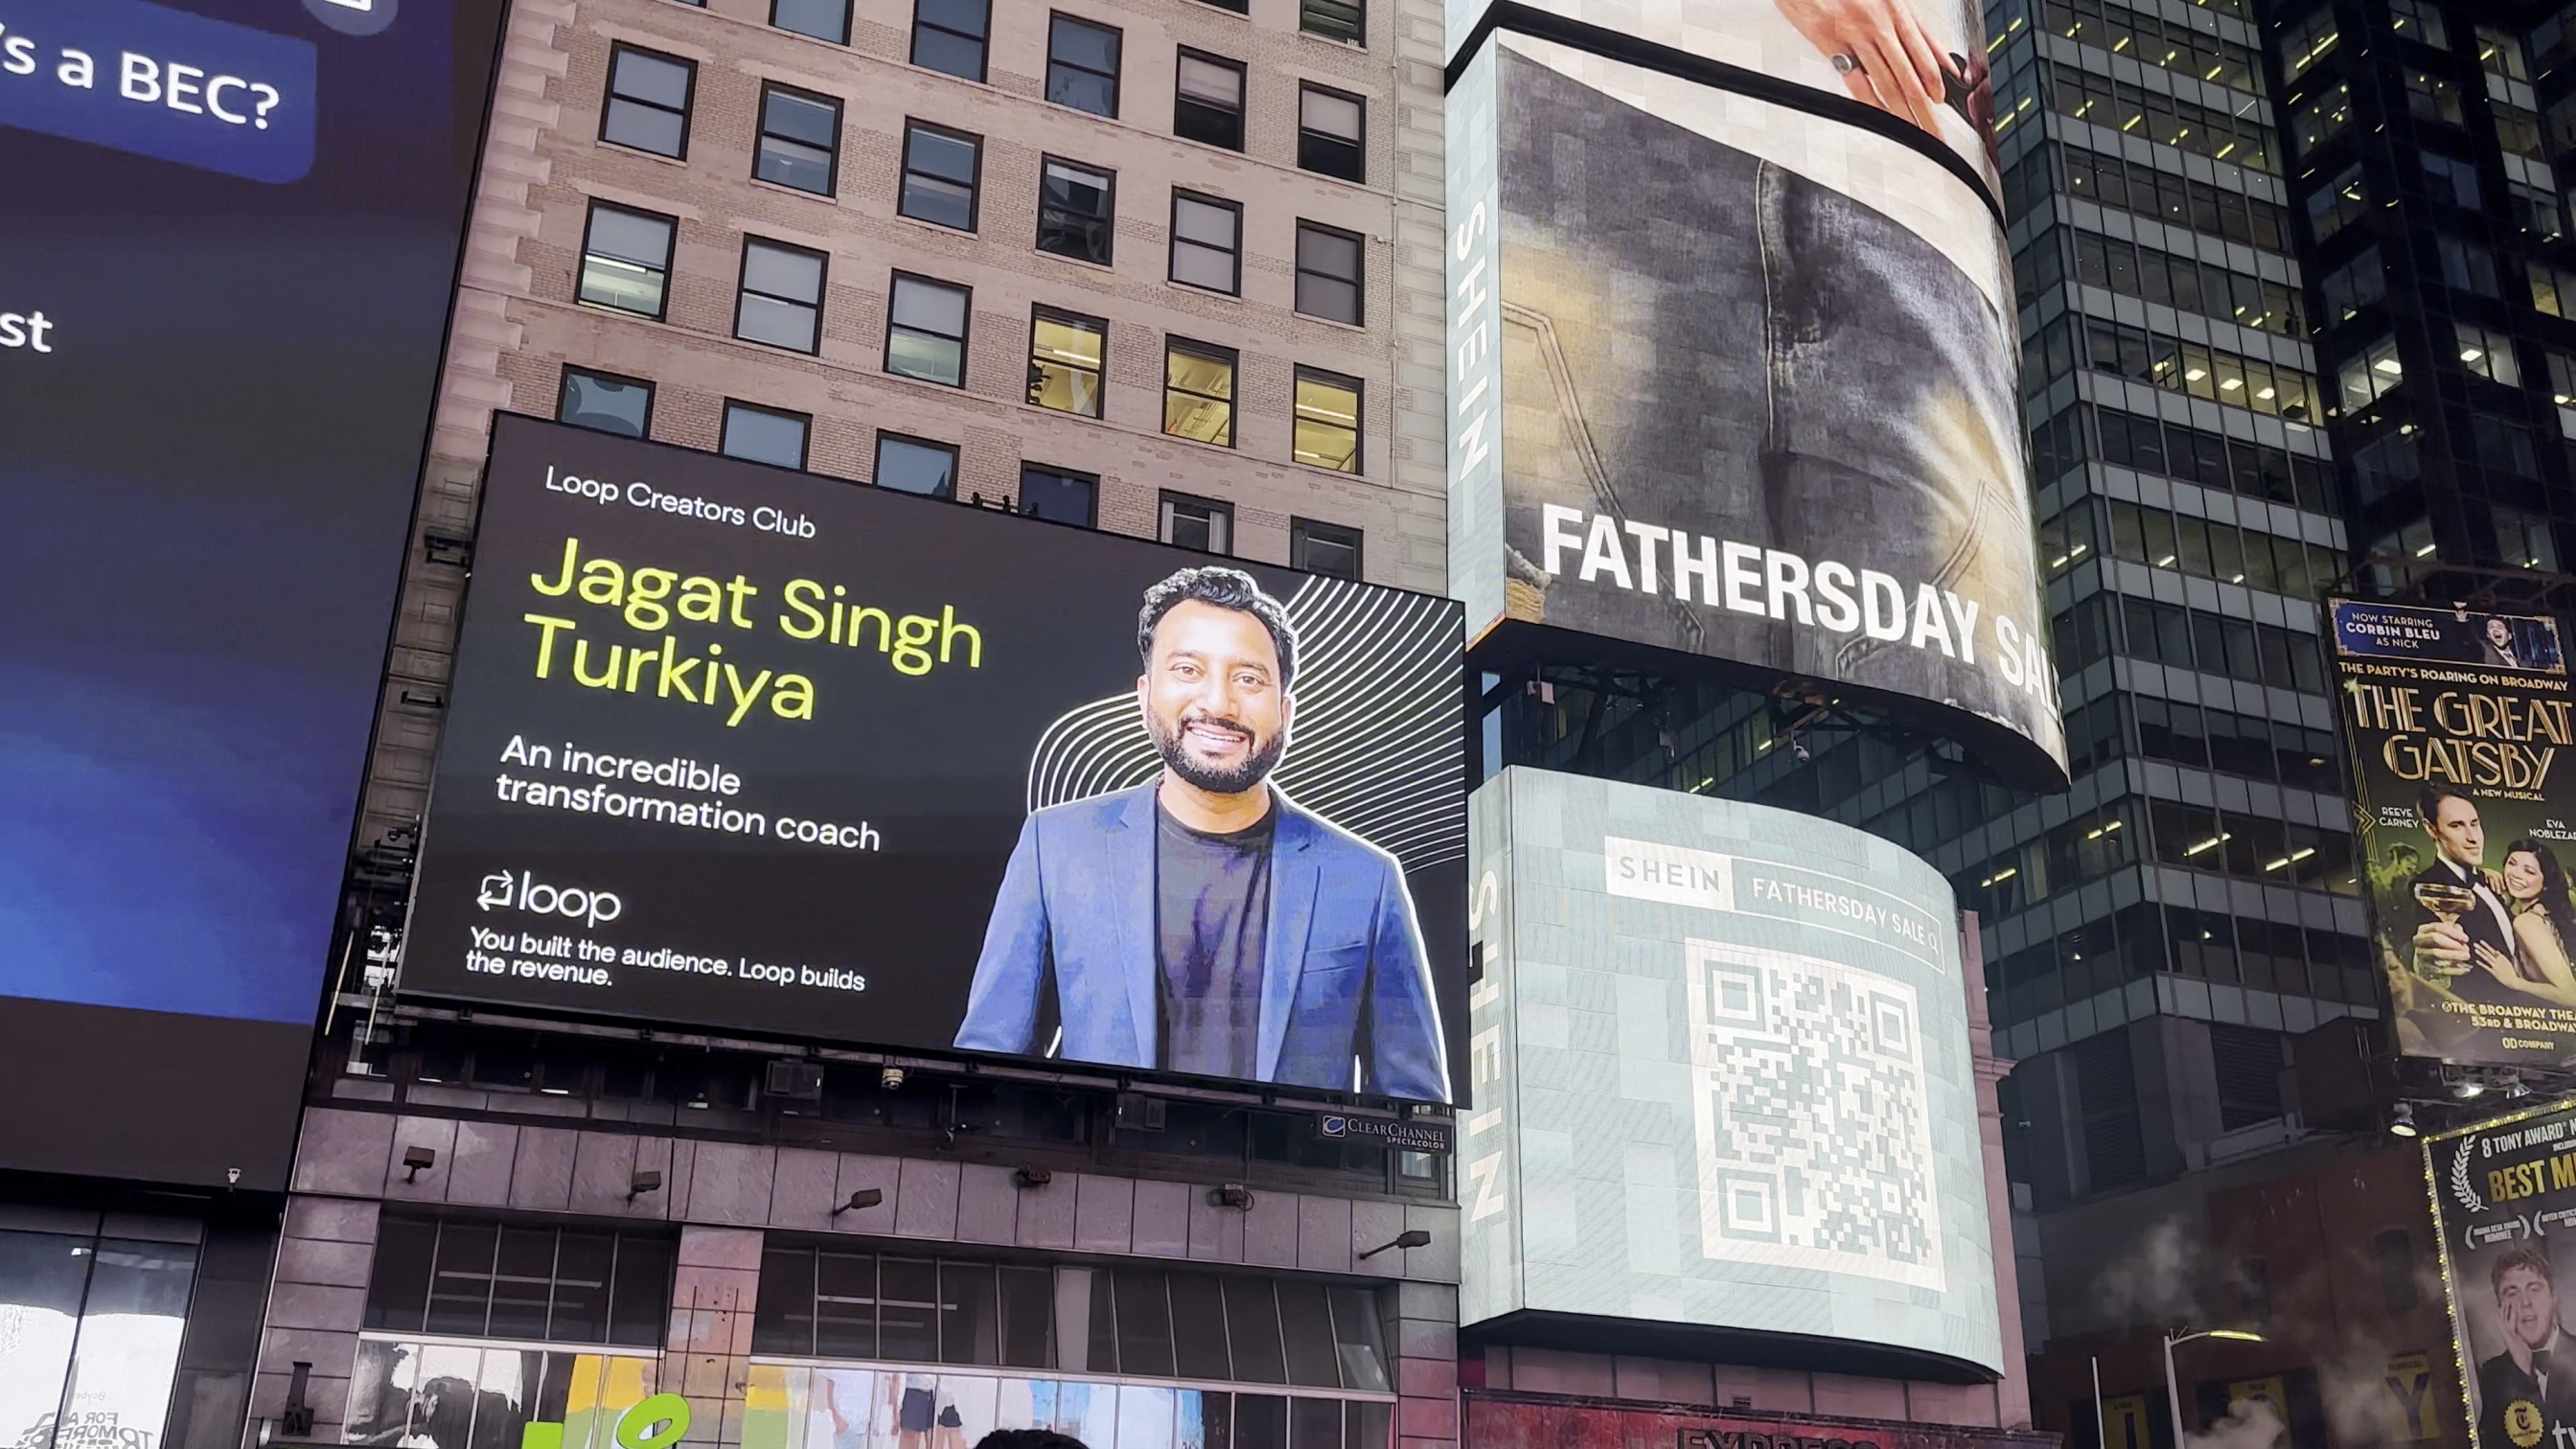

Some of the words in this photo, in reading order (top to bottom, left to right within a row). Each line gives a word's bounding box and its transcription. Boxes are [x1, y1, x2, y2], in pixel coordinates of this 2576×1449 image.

[58, 49, 94, 89] a
[121, 51, 280, 130] BEC?
[1457, 200, 1488, 483] SHEIN
[545, 466, 619, 505] Loop
[626, 482, 746, 527] Creators
[752, 505, 816, 539] Club
[1541, 503, 1979, 665] FATHERSDAY
[530, 537, 758, 632] Jagat
[778, 577, 982, 676] Singh
[2352, 612, 2379, 624] NOW
[2381, 615, 2433, 628] STARRING
[2345, 622, 2401, 637] CORBIN
[2405, 628, 2440, 640] BLEU
[2376, 636, 2389, 646] AS
[2392, 638, 2420, 649] NICK
[523, 613, 816, 727] Turkiya
[2338, 661, 2365, 674] THE
[2368, 664, 2418, 678] PARTY'S
[2421, 669, 2476, 683] ROARING
[2479, 674, 2499, 685] ON
[2502, 676, 2568, 691] BROADWAY
[2351, 684, 2426, 733] THE
[2433, 691, 2574, 746] GREAT
[499, 734, 552, 770] An
[562, 742, 742, 796] incredible
[2382, 734, 2556, 790] GATSBY
[495, 773, 766, 836] transformation
[775, 816, 881, 852] coach
[2381, 806, 2413, 817] REEVE
[2481, 790, 2502, 798] NEW
[2504, 791, 2545, 801] MUSICAL
[2379, 817, 2421, 829] CARNEY
[2546, 818, 2566, 830] EVA
[518, 871, 622, 929] loop
[1620, 856, 1720, 892] SHEIN
[1752, 877, 1887, 930] FATHERSDAY
[1892, 912, 1926, 946] SALE
[465, 950, 506, 975] the
[511, 956, 613, 987] revenue.
[470, 926, 515, 953] You
[520, 932, 573, 958] built
[578, 938, 616, 963] the
[621, 947, 733, 978] audience.
[739, 957, 796, 988] Loop
[800, 964, 866, 993] builds
[2450, 1002, 2476, 1014] THE
[2479, 1004, 2546, 1019] BROADWAY
[2549, 1009, 2576, 1022] THE
[2503, 1018, 2513, 1028] &
[2518, 1039, 2555, 1050] COMPANY
[1387, 1136, 1445, 1150] SPECTACOLOR
[2482, 1138, 2492, 1158] 8
[2493, 1133, 2525, 1153] TONY
[2488, 1160, 2545, 1203] BEST
[2550, 1152, 2576, 1190] M
